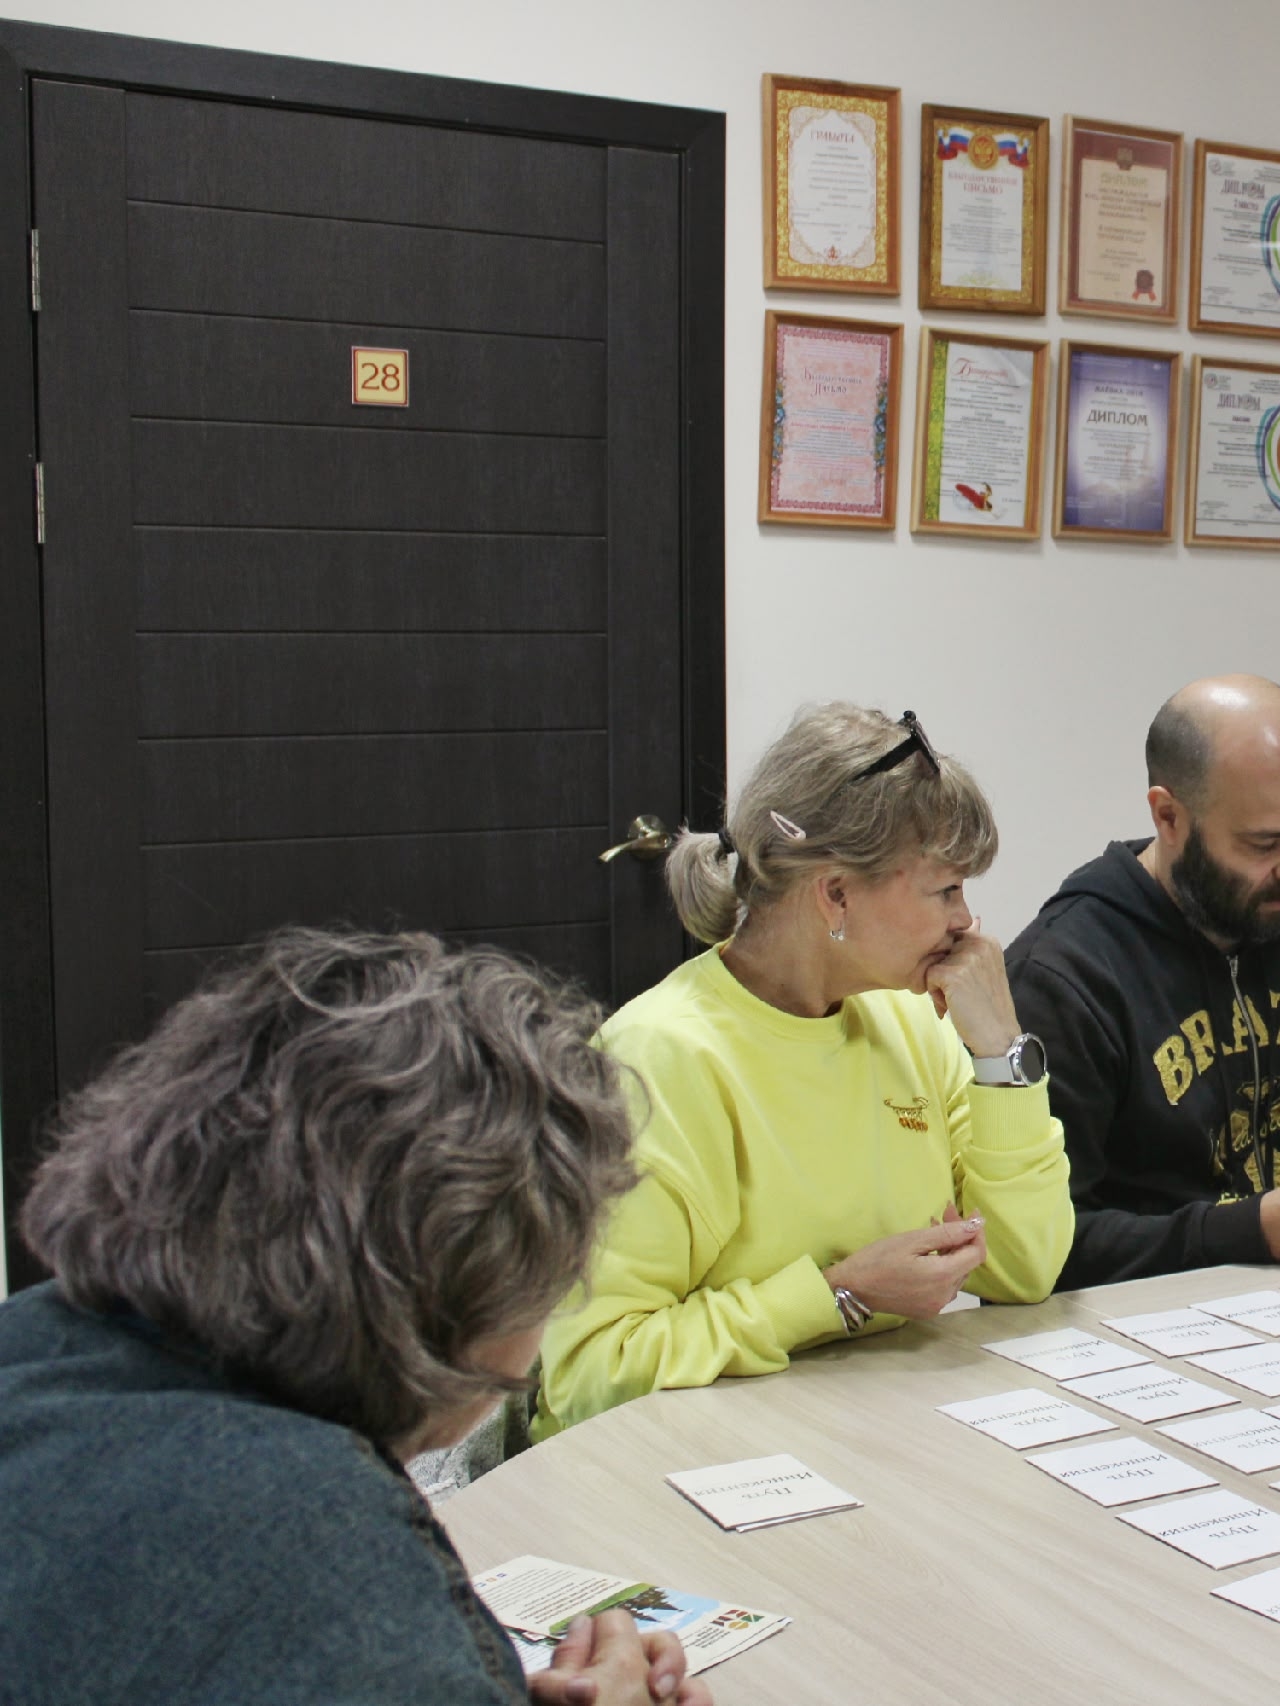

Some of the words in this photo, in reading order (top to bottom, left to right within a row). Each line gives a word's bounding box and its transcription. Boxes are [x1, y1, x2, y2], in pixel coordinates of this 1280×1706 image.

[361, 362, 401, 392] 28
[1087, 408, 1149, 427] ДИПЛОМ
[1170, 1328, 1211, 1339] Путь
[1094, 1376, 1189, 1400] Иннокентия
[1136, 1388, 1180, 1401] Путь
[1013, 1414, 1057, 1426] Путь
[1237, 1437, 1280, 1450] Путь
[1059, 1453, 1167, 1477] Иннокентия
[1106, 1467, 1154, 1480] Путь
[693, 1472, 813, 1496] Иннокентия
[741, 1486, 792, 1499] Путь
[1158, 1507, 1268, 1538] Иннокентия
[1208, 1522, 1259, 1542] Путь
